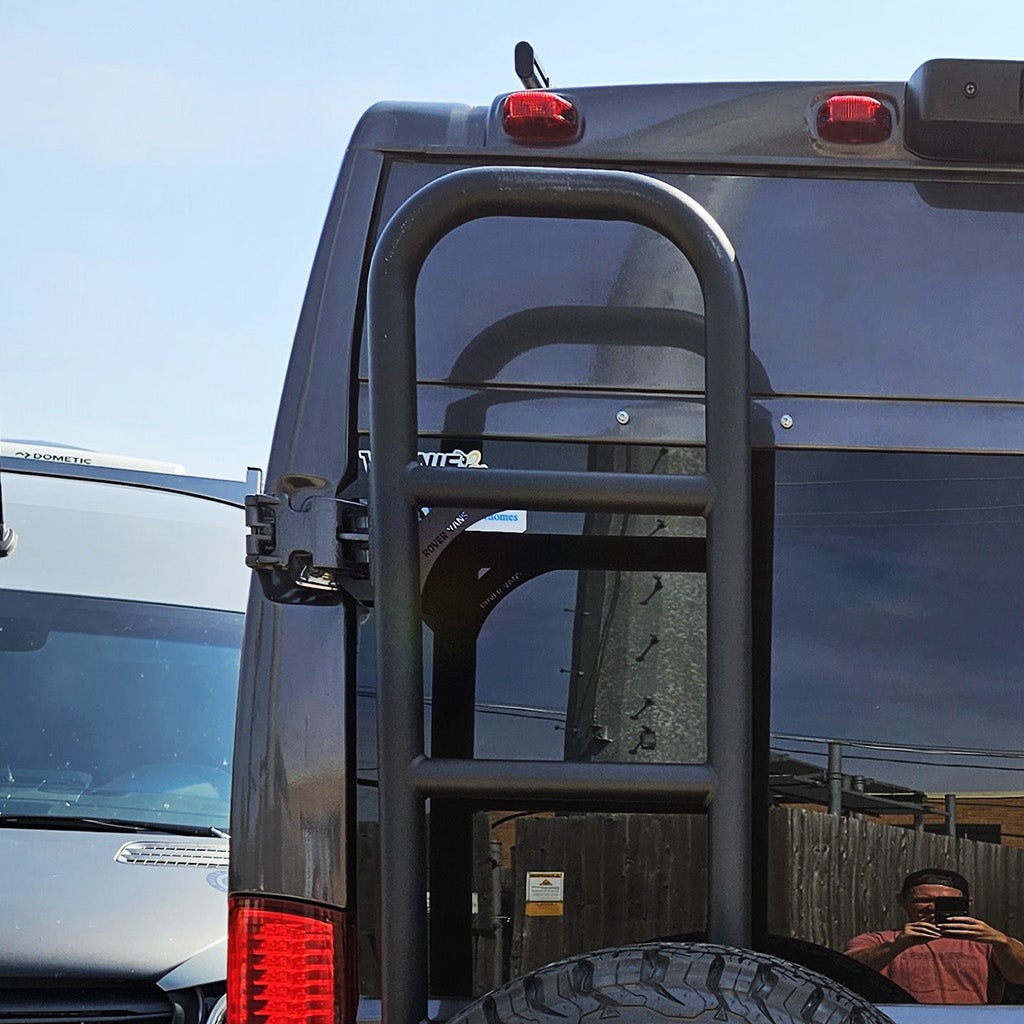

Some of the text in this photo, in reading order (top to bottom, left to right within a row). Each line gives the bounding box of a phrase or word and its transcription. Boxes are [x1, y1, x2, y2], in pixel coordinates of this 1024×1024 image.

[33, 452, 92, 464] DOMETIC
[422, 511, 469, 558] ROVER VANS
